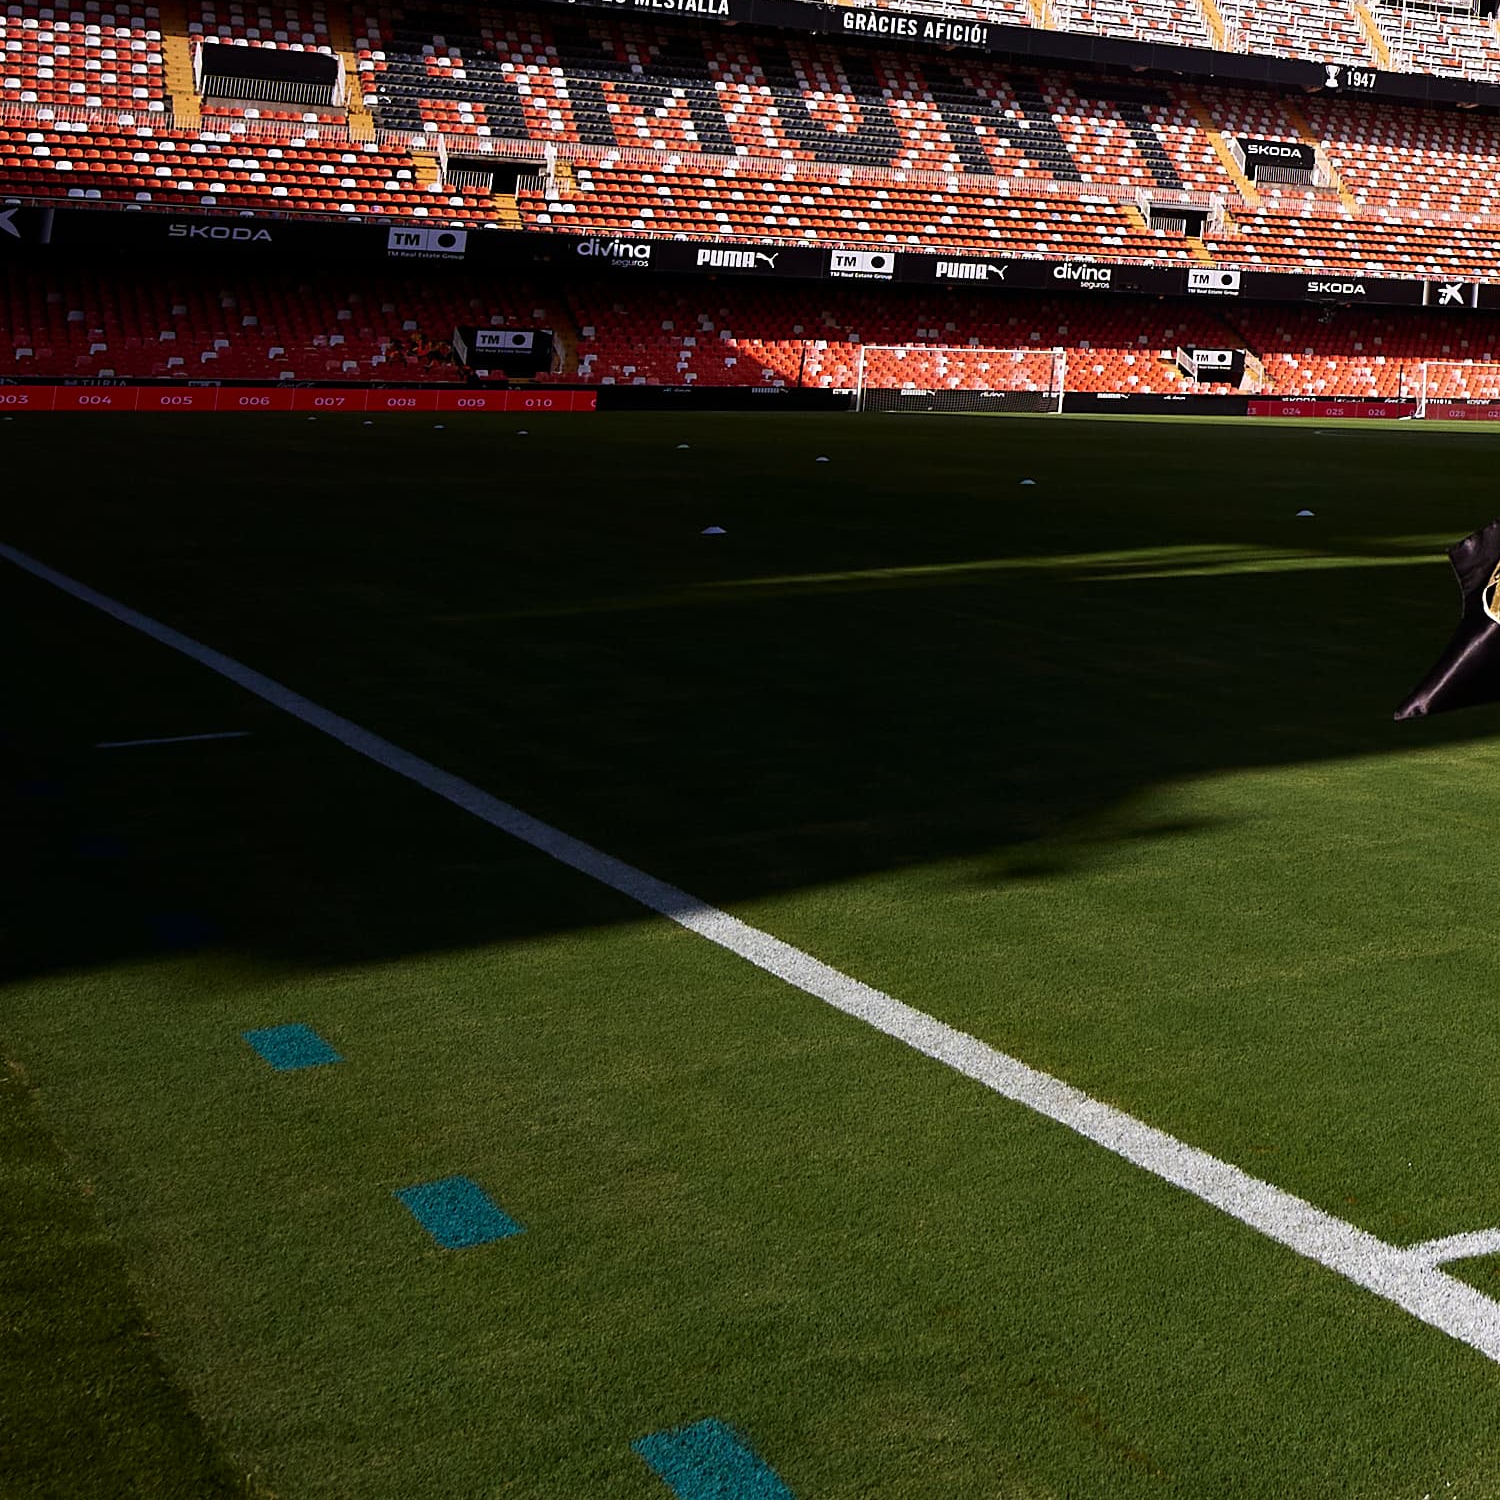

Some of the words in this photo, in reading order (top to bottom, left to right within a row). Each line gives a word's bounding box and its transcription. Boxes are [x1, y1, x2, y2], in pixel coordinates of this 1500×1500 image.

[843, 10, 918, 37] GRÀCIES
[923, 14, 988, 43] AFICIÓ!
[1346, 71, 1376, 89] 1947
[395, 233, 419, 246] TM
[577, 238, 651, 259] divina
[611, 258, 649, 268] seguros
[697, 248, 756, 268] PUMA
[836, 256, 856, 266] TM
[935, 261, 989, 281] PUMA
[1053, 262, 1111, 282] divina
[1080, 280, 1110, 290] seguros
[1192, 275, 1209, 285] TM
[480, 335, 499, 345] TM
[1196, 354, 1208, 362] TM
[79, 396, 112, 405] 004
[160, 396, 192, 405] 005
[239, 397, 270, 406] 006
[314, 397, 345, 407] 007
[387, 398, 416, 407] 008
[457, 398, 485, 408] 009
[525, 399, 552, 408] 010
